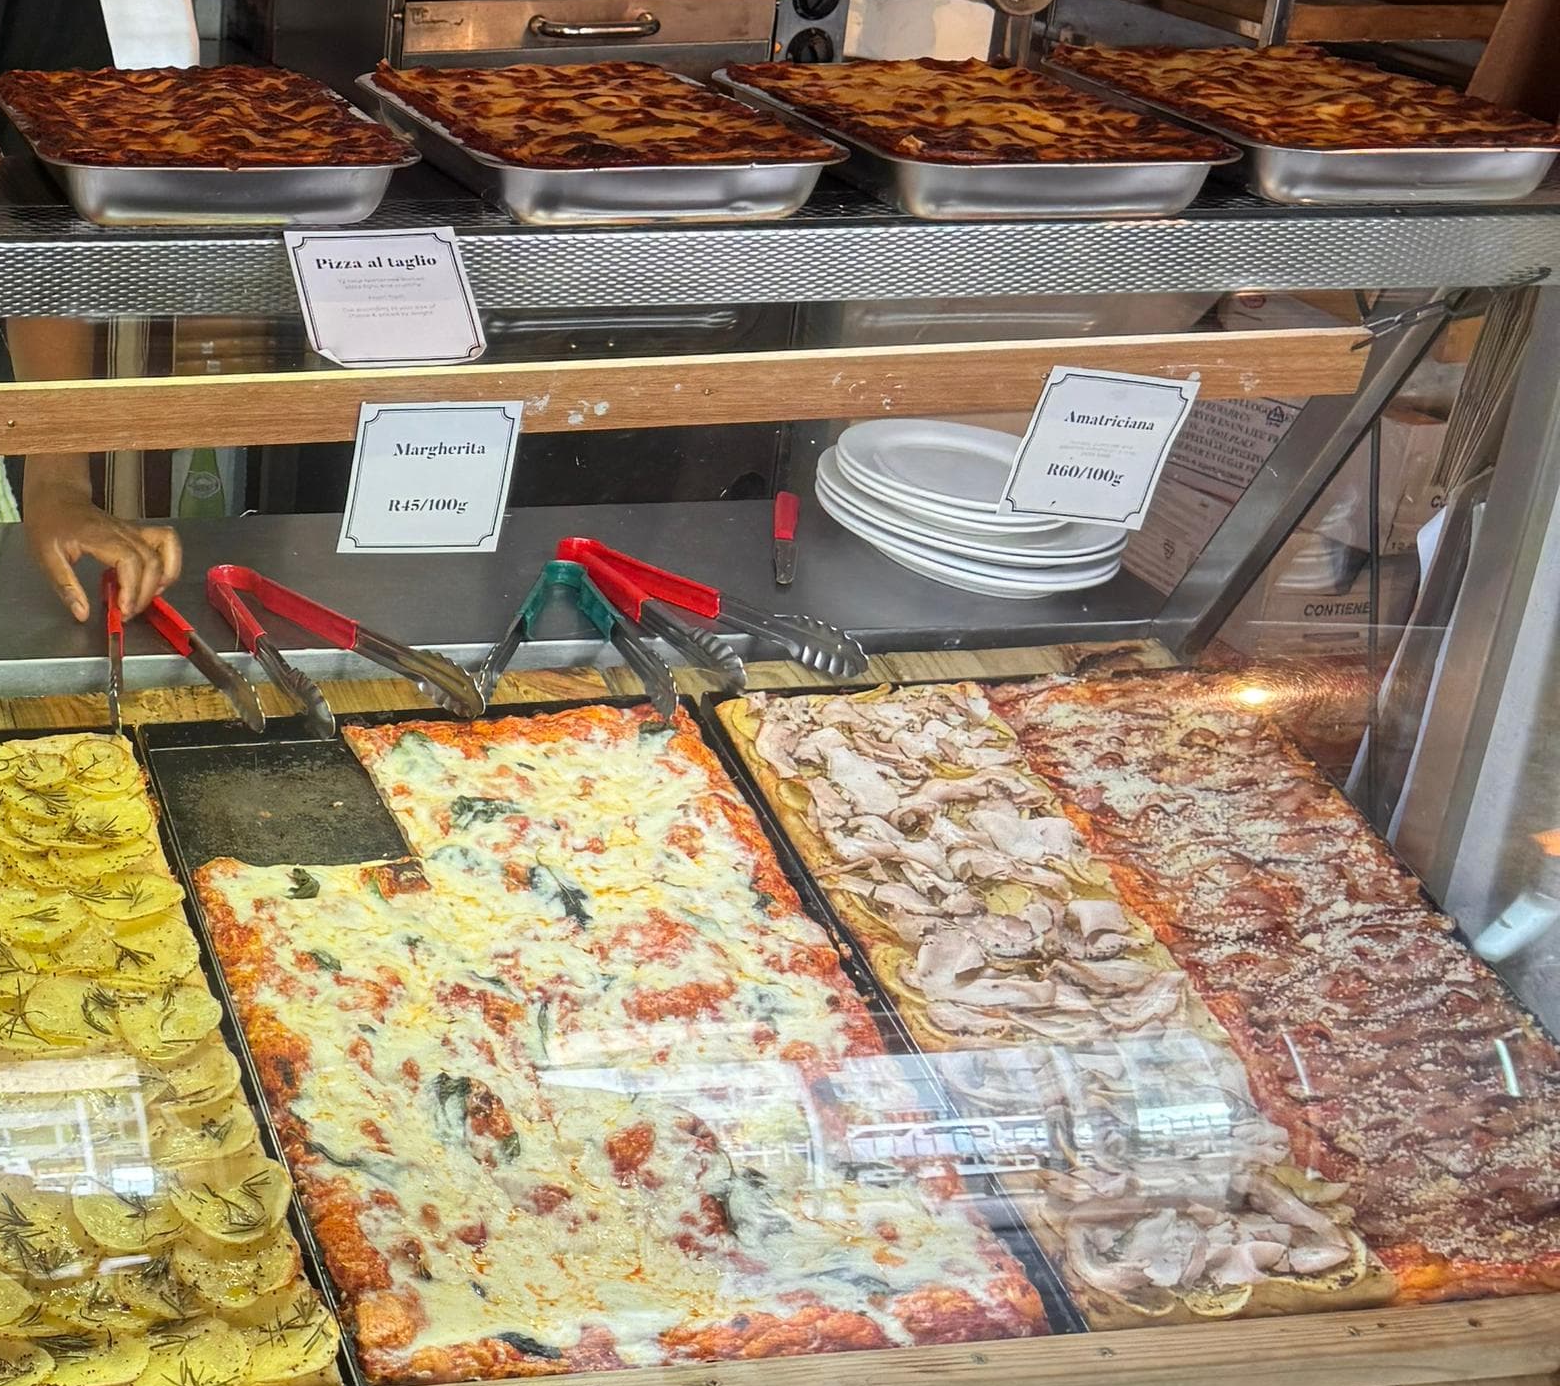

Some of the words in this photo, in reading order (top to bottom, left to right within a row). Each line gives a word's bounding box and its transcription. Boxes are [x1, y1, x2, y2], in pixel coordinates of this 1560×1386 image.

[315, 256, 363, 270] Pizza
[368, 256, 383, 268] al
[389, 254, 437, 270] taglio
[1064, 410, 1155, 431] Amatriciana
[393, 442, 486, 459] Margherita
[1047, 463, 1124, 487] R60/100g
[388, 498, 469, 514] R45/100g
